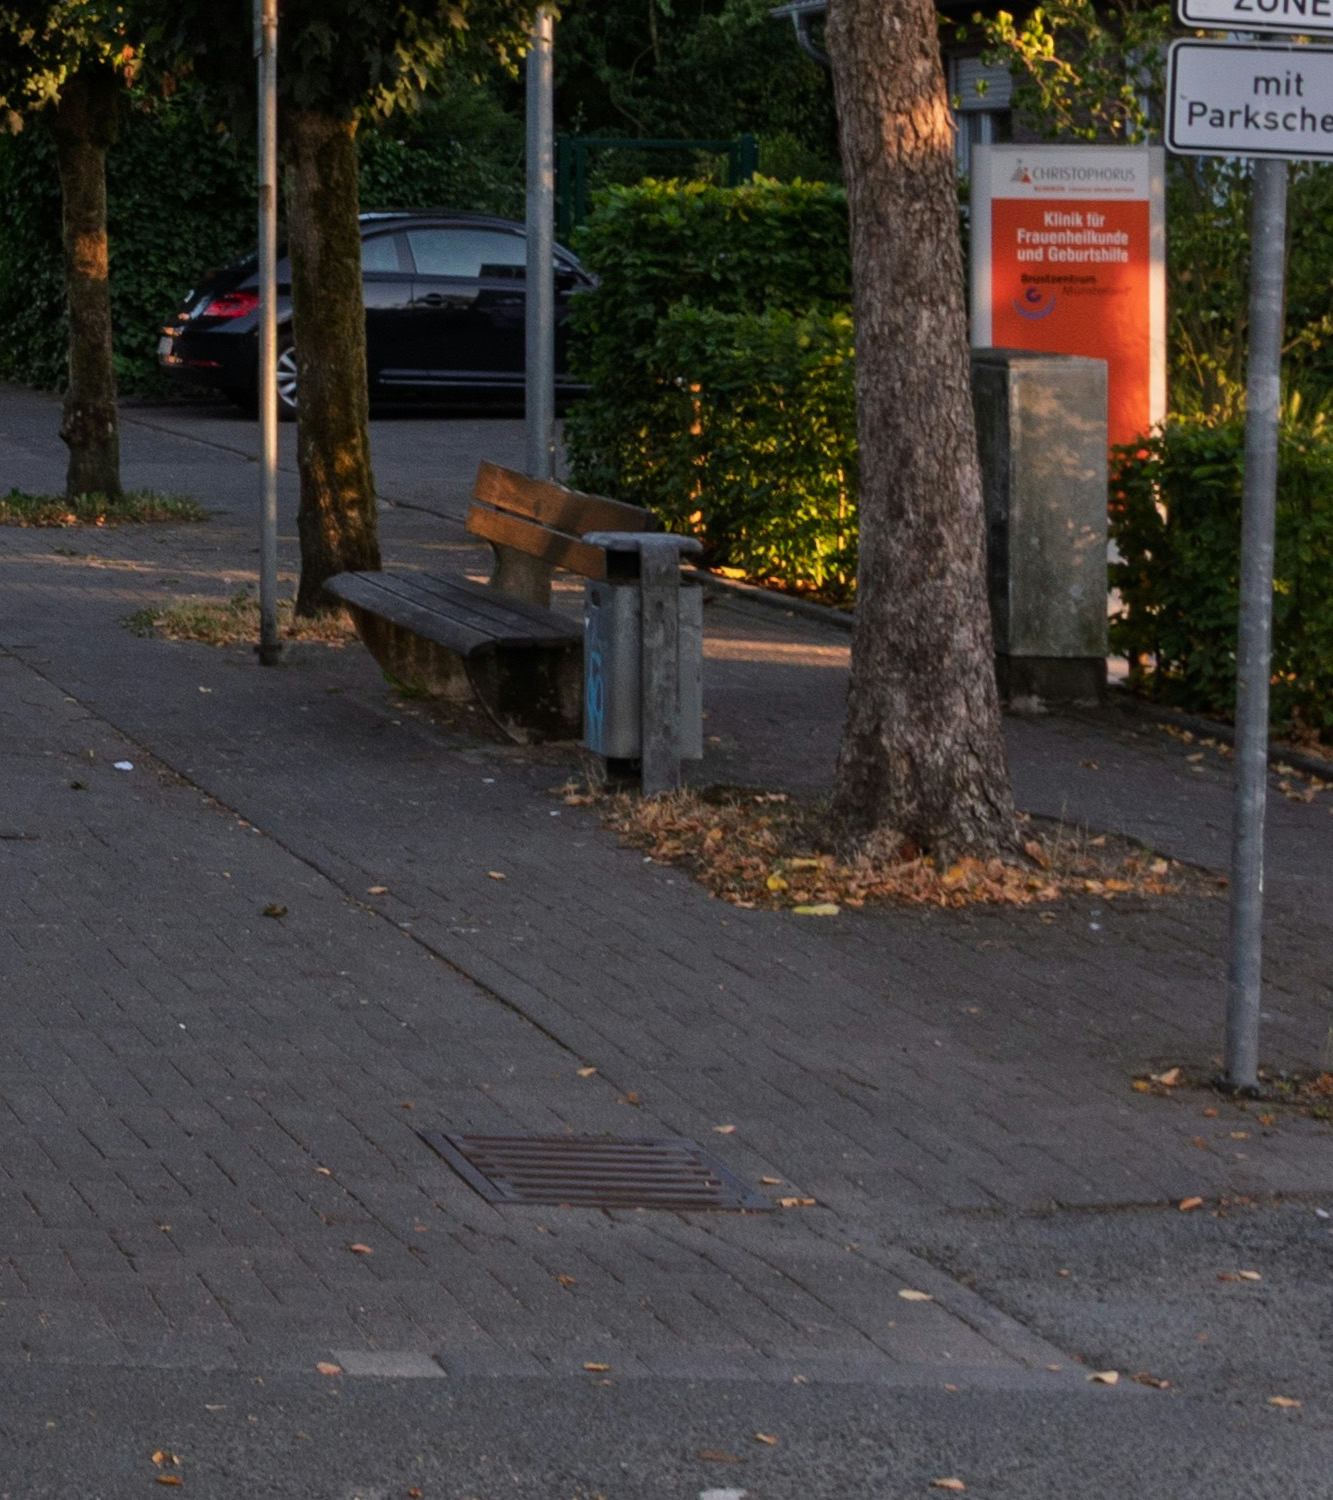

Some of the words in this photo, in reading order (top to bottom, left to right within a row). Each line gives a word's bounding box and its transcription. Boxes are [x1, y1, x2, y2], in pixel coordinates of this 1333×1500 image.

[1253, 70, 1304, 97] mit
[1188, 101, 1333, 134] Parksche
[1033, 166, 1135, 182] CHRISTOPHORUS
[1044, 211, 1083, 227] Klinik
[1086, 211, 1105, 227] für
[1017, 228, 1129, 245] Frauenheilkunde
[1017, 246, 1044, 262] und
[1048, 246, 1129, 262] Geburtshilfe
